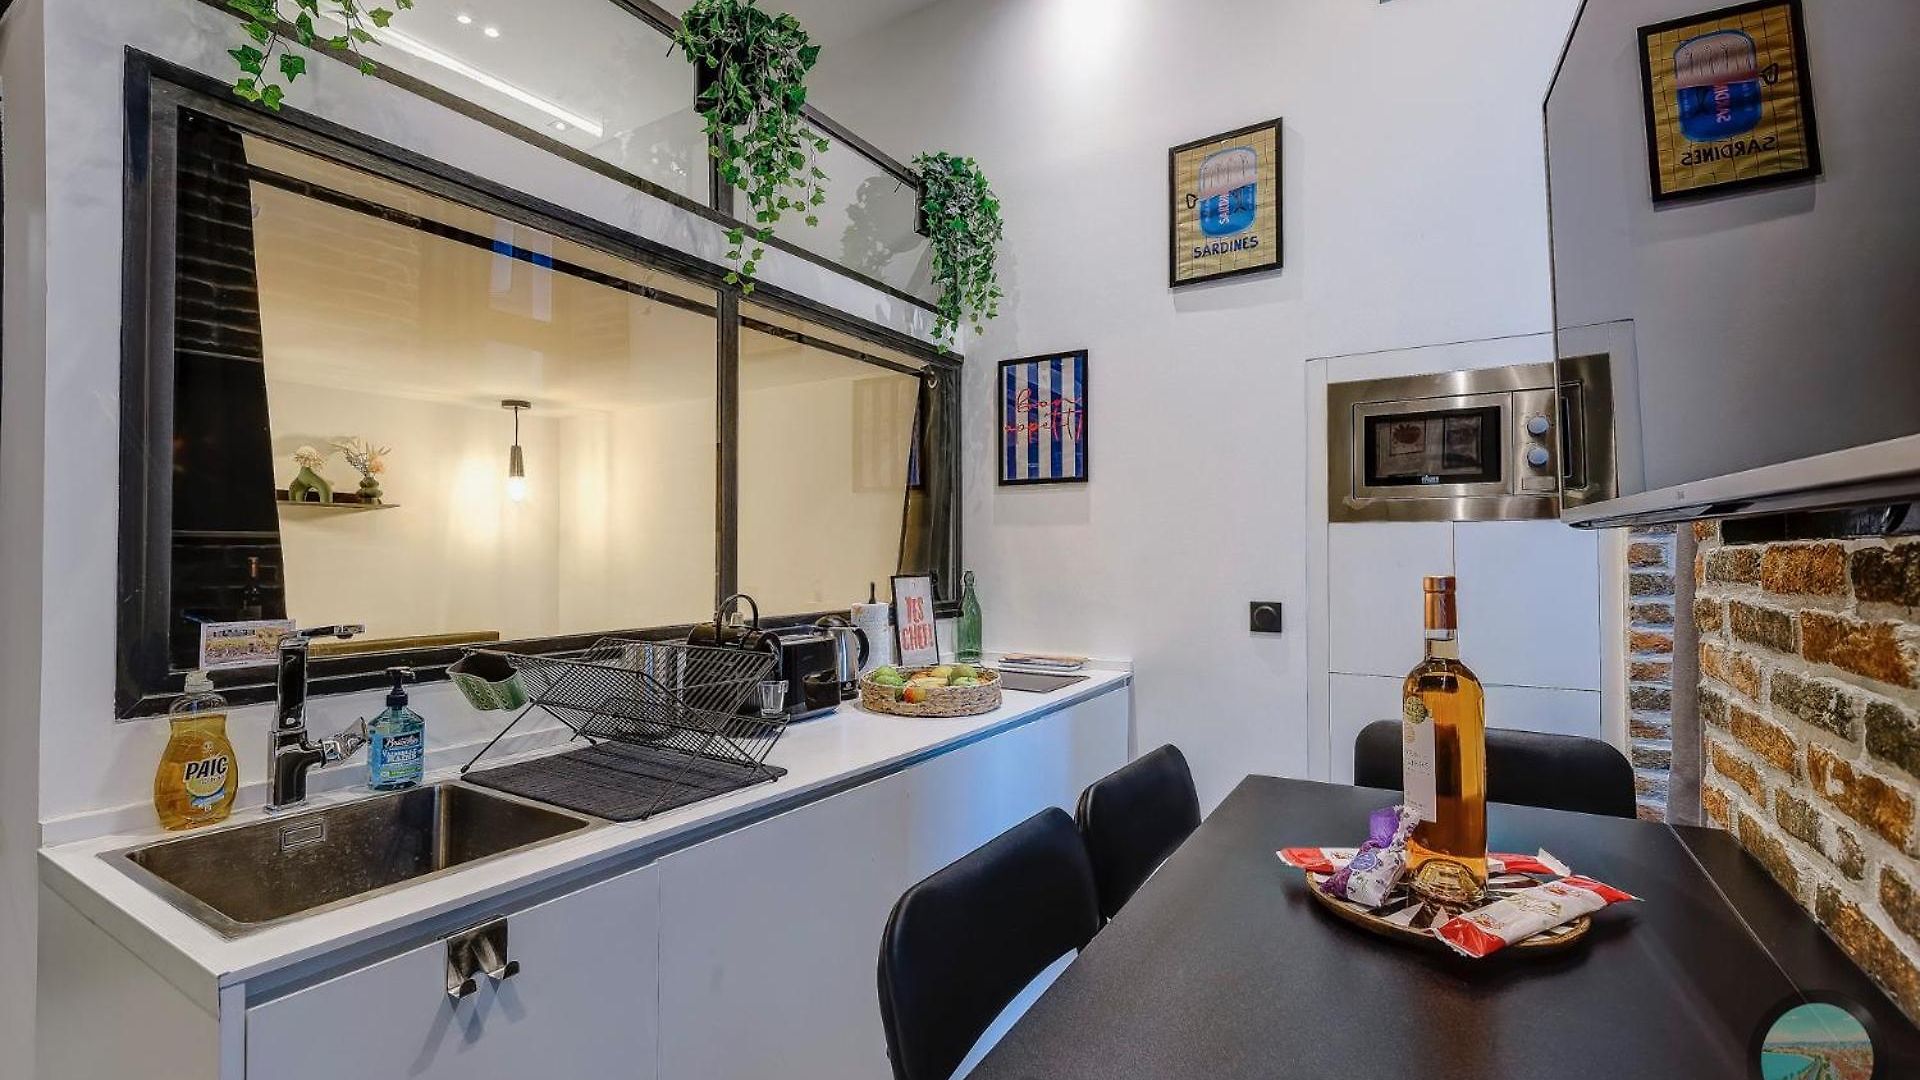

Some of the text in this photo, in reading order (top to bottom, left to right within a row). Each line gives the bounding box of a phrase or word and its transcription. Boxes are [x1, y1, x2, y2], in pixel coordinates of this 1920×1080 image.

[1193, 236, 1258, 259] SARDINES
[904, 596, 924, 623] YES
[902, 623, 934, 651] CHEF!
[185, 757, 228, 781] PAIC
